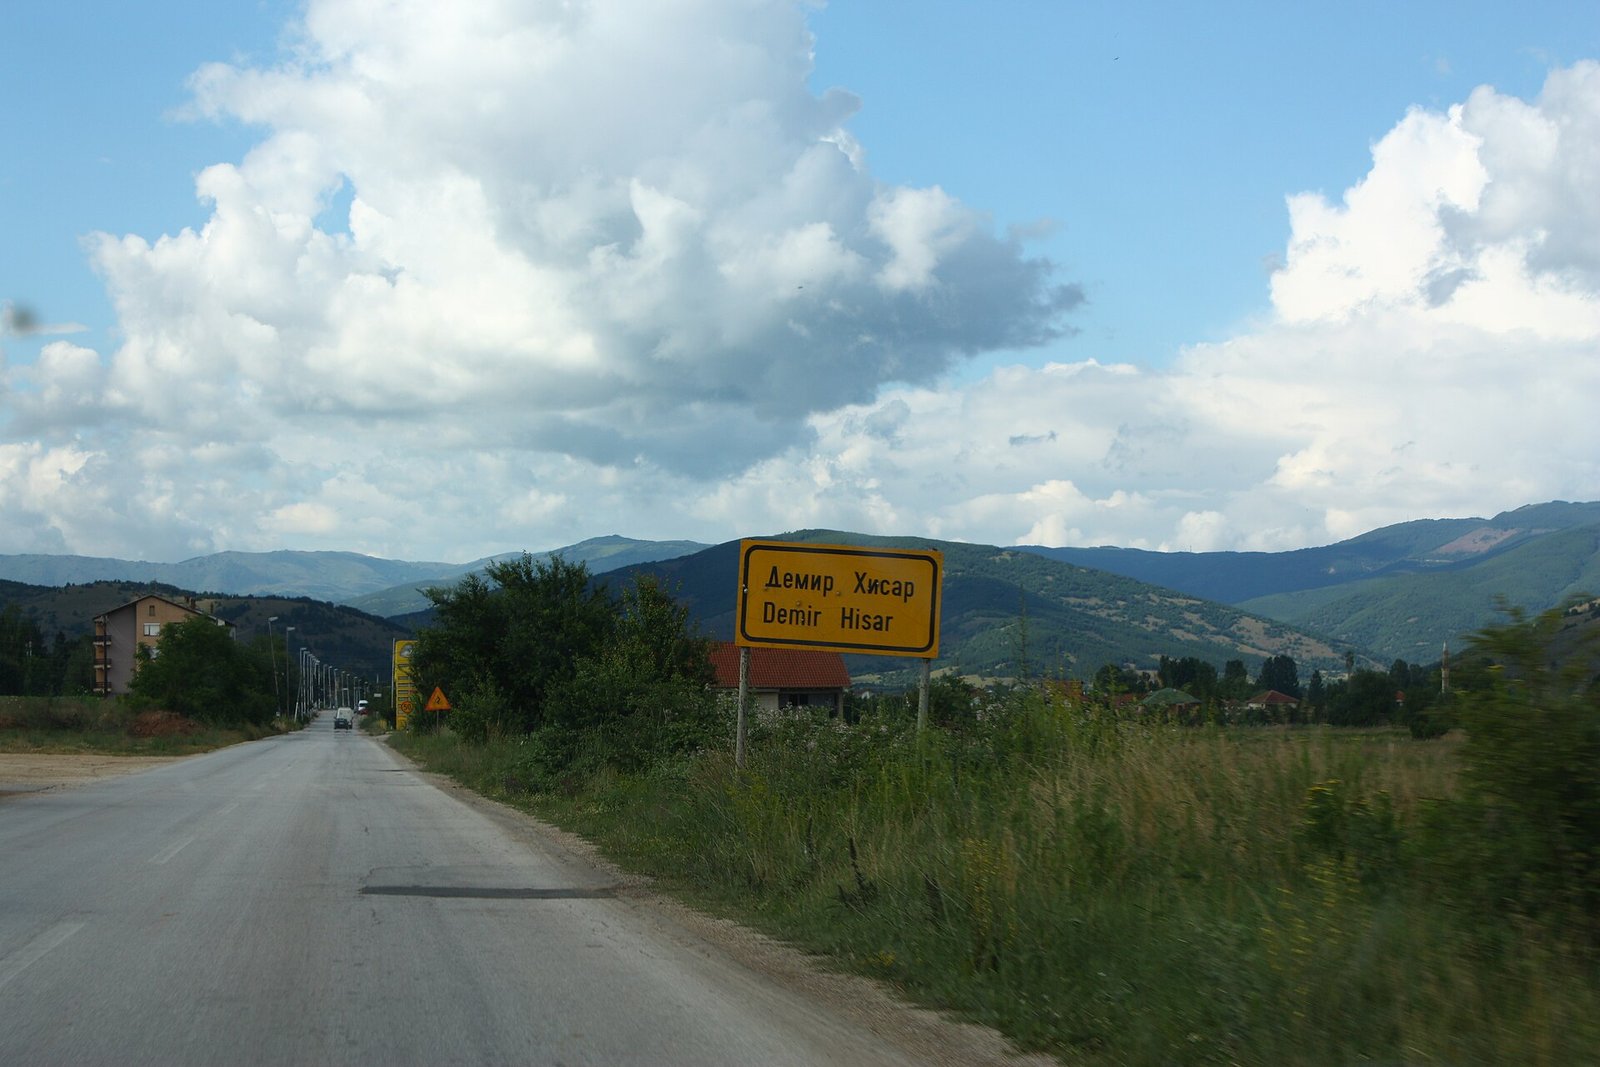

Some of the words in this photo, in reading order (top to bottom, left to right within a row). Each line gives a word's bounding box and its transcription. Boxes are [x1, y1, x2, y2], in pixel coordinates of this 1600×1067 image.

[765, 566, 834, 597] Демир
[854, 572, 914, 603] Хисар
[763, 601, 822, 627] Demir
[840, 607, 894, 631] Hisar
[403, 703, 412, 711] 50
